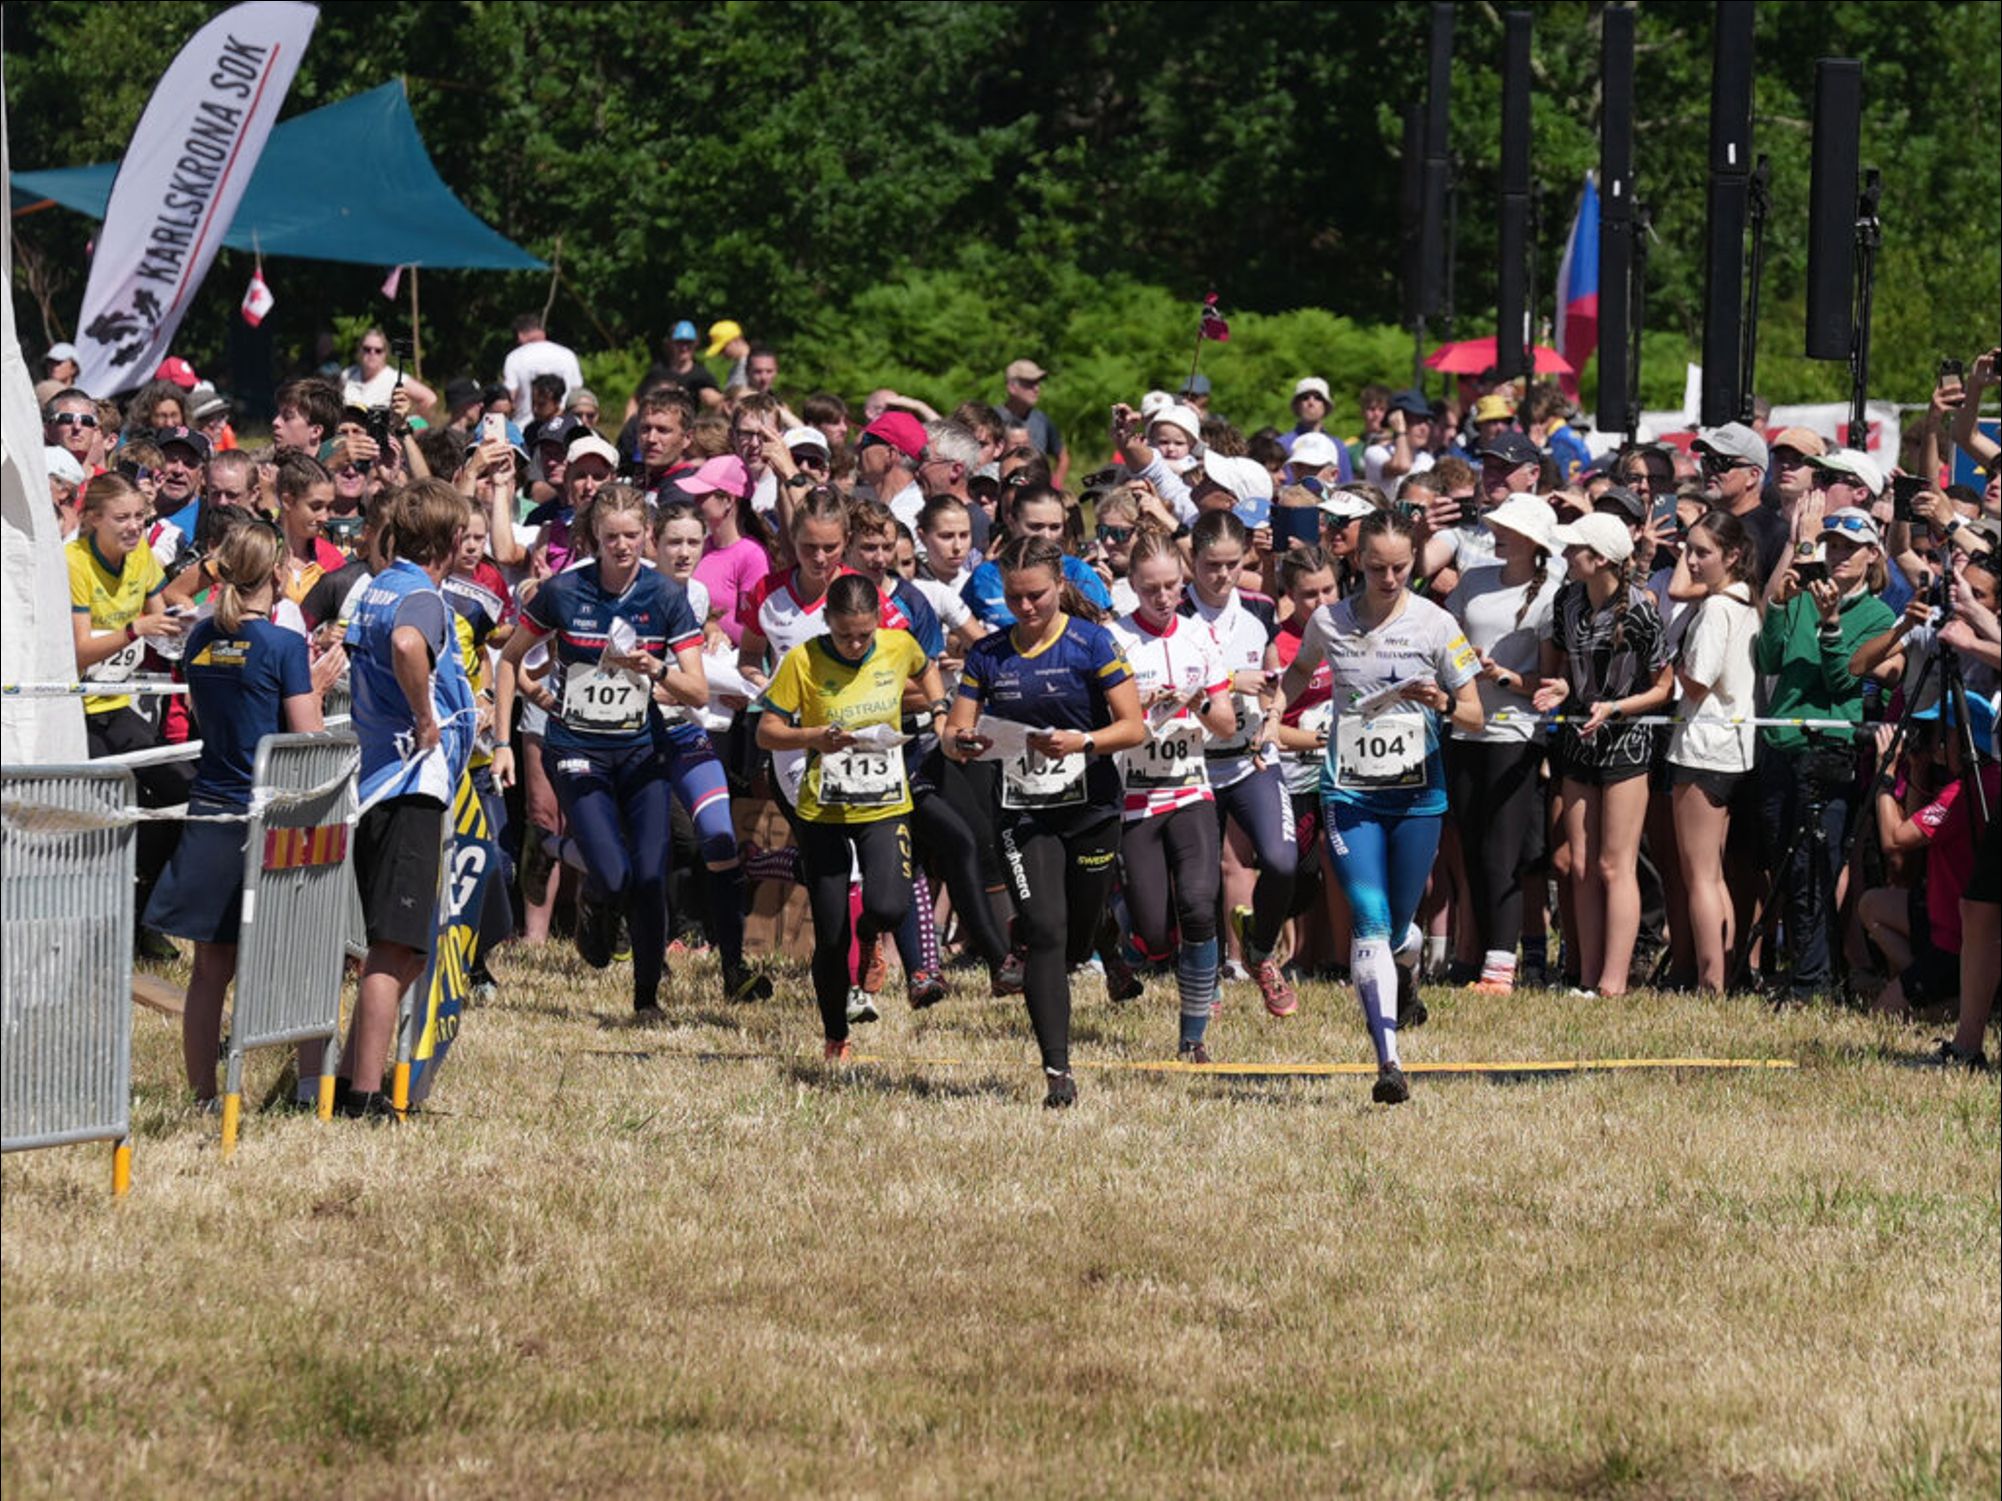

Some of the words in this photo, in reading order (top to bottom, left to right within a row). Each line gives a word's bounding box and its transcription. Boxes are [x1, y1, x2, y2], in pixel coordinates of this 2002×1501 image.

[136, 101, 242, 285] KARLSKRONA
[210, 34, 267, 98] SOK
[584, 684, 632, 705] 107
[1144, 739, 1188, 761] 108
[1355, 735, 1406, 758] 104
[840, 757, 888, 776] 113
[895, 823, 912, 879] AUS
[1001, 828, 1032, 900] bagheera
